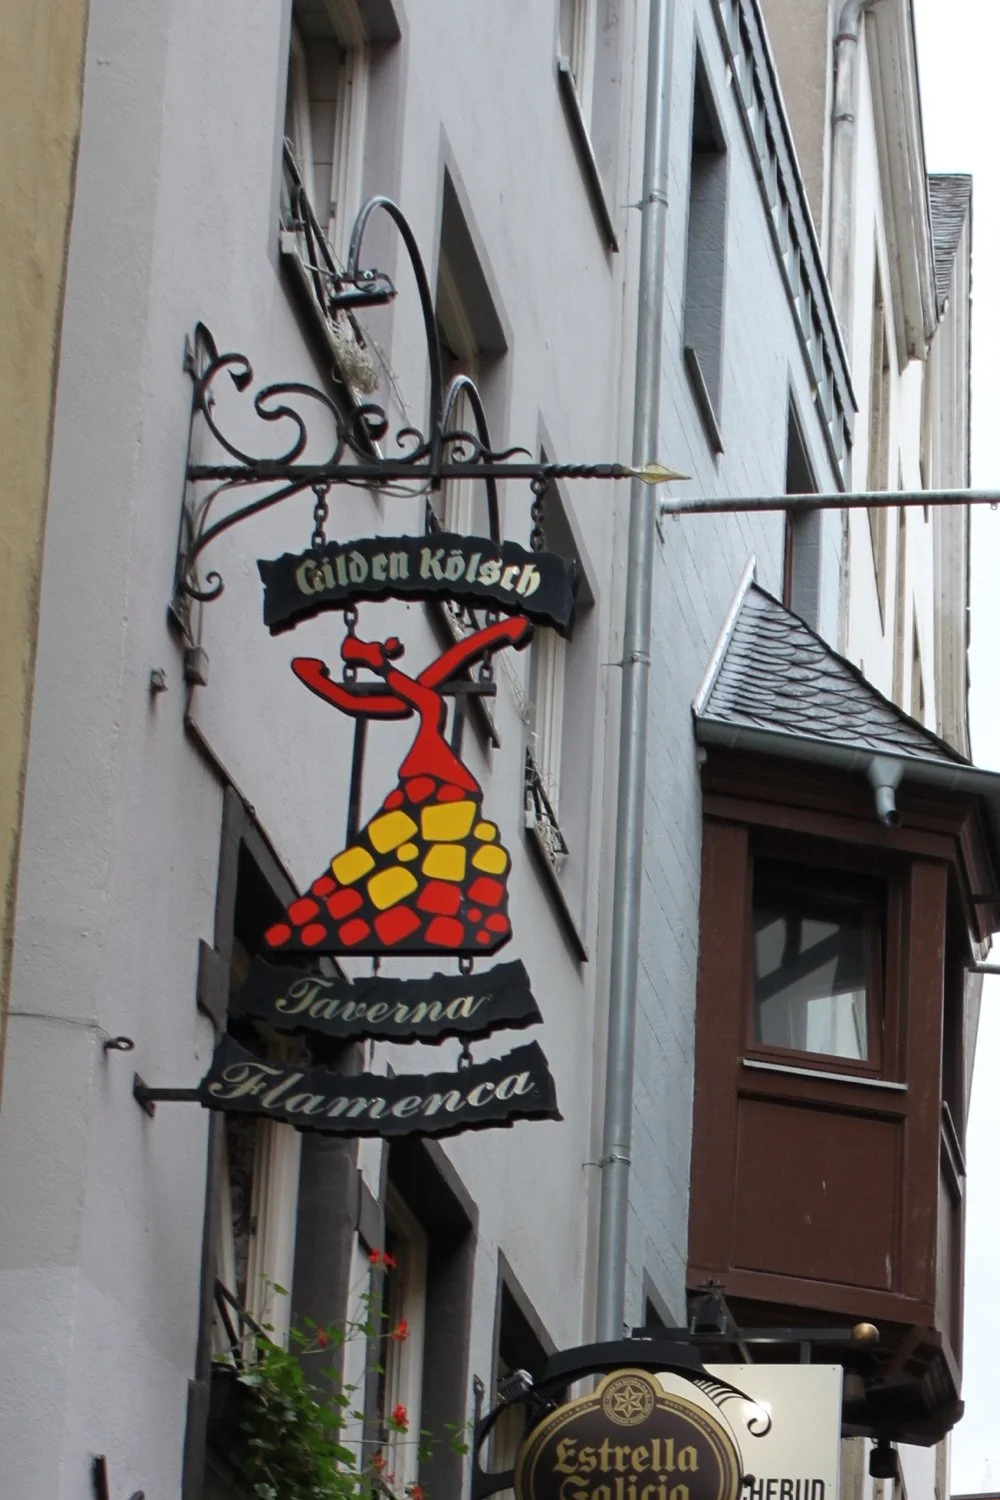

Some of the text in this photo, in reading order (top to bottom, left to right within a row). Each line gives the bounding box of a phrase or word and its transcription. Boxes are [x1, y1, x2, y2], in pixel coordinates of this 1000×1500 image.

[298, 546, 542, 598] Gilden Kölsch
[275, 976, 492, 1025] Taverna
[210, 1061, 535, 1121] Flamenca
[552, 1437, 701, 1474] Estrella
